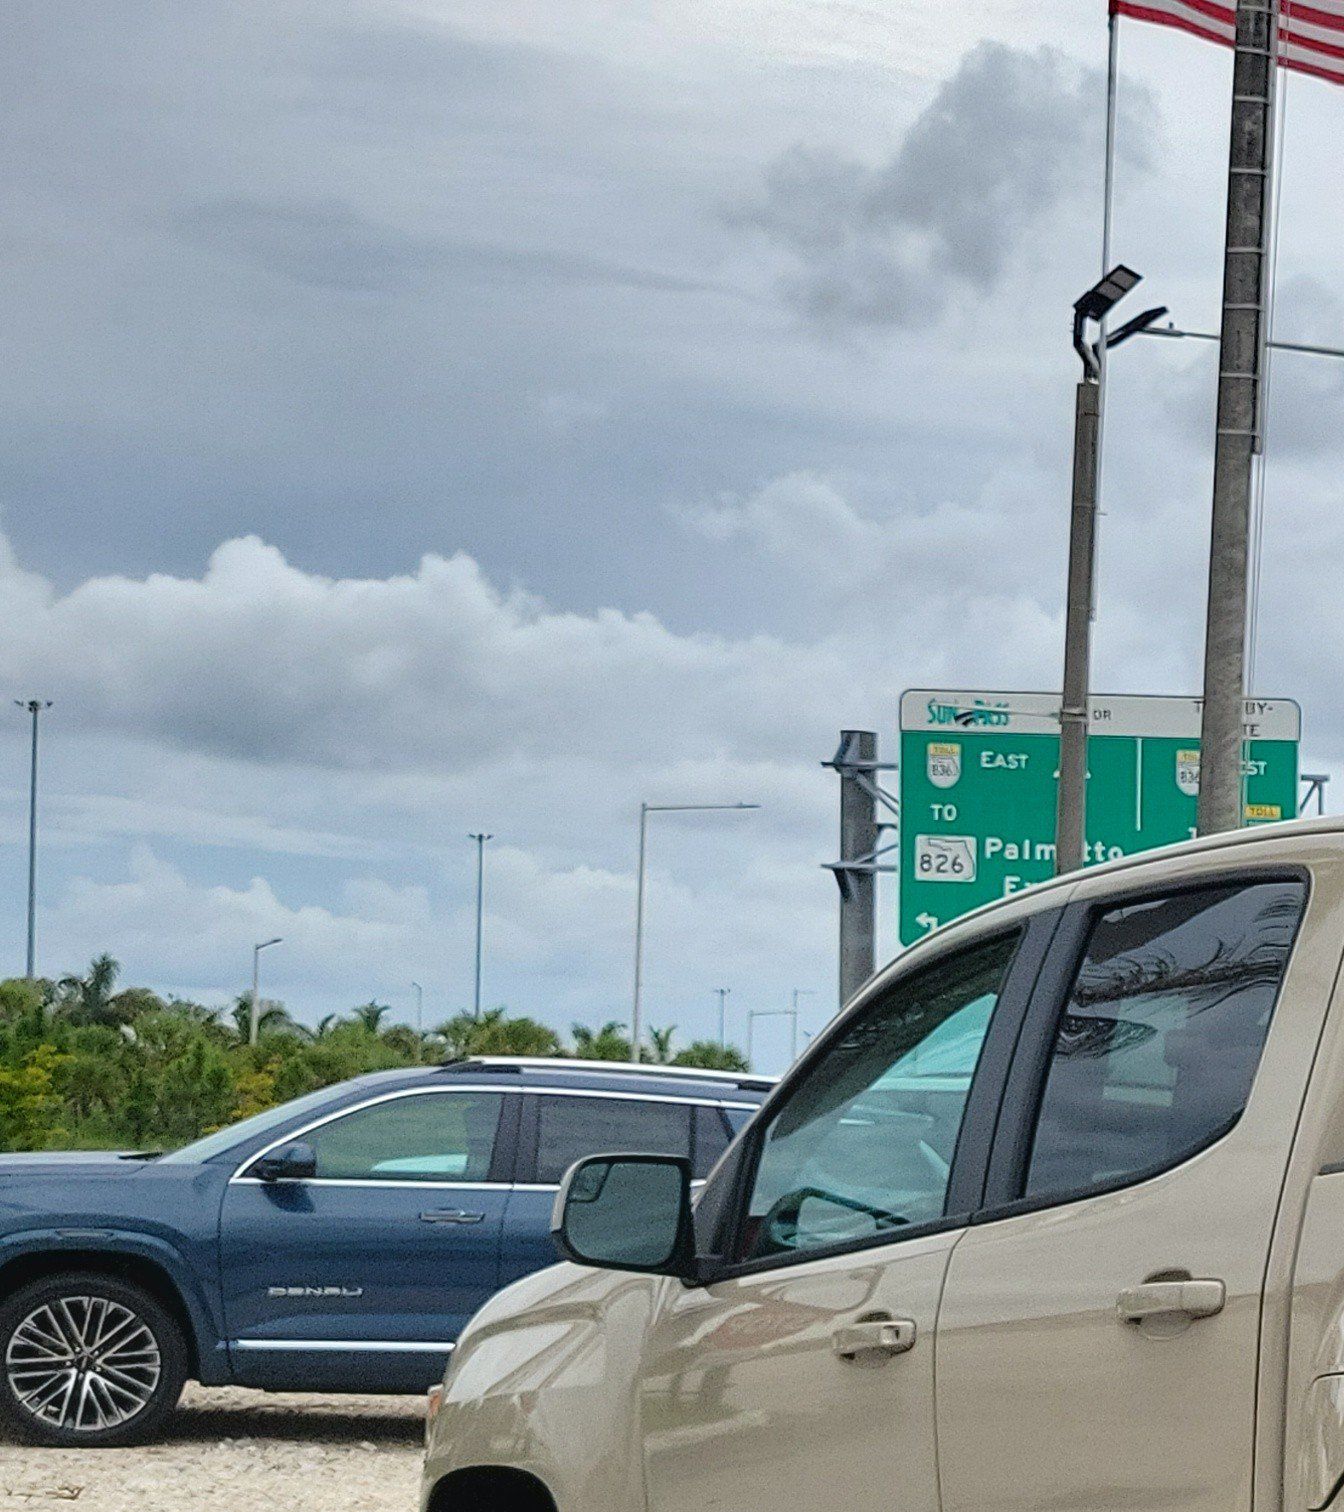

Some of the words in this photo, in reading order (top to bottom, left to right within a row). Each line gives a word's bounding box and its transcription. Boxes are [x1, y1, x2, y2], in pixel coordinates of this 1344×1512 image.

[979, 750, 1029, 770] EAST
[930, 803, 957, 821] TO
[919, 853, 965, 874] 826
[984, 837, 1124, 862] Palmtto
